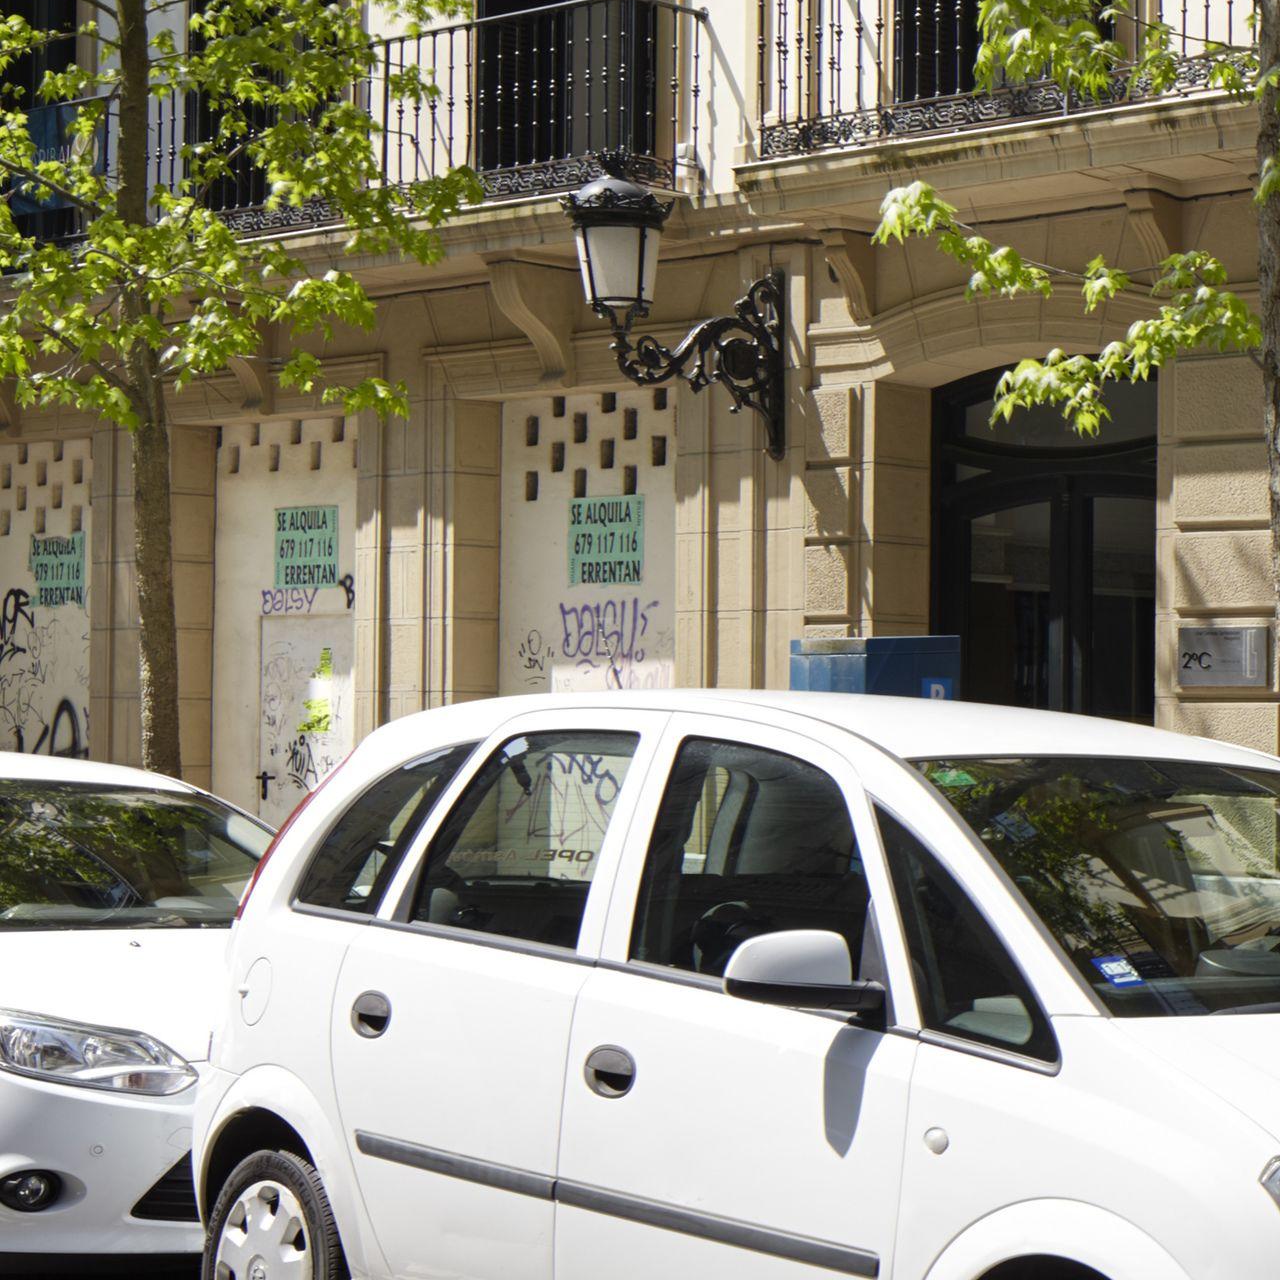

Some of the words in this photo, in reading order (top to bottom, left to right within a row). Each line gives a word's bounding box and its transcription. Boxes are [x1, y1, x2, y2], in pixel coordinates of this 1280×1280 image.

[277, 512, 287, 532] SE
[289, 510, 328, 534] ALQUILA
[571, 503, 582, 525] SE
[585, 501, 632, 527] ALQUILA
[32, 538, 41, 557] SE
[43, 537, 76, 558] ALQUILA
[280, 539, 295, 559] 679
[298, 538, 314, 558] 117
[317, 536, 333, 557] 116
[574, 533, 592, 555] 679
[597, 532, 615, 554] 117
[619, 531, 637, 553] 116
[35, 563, 48, 582] 679
[51, 562, 64, 581] 117
[66, 561, 80, 580] 116
[285, 564, 336, 585] ERRENTAN
[581, 560, 641, 584] ERRENTAN
[40, 586, 82, 607] ERRENTAN
